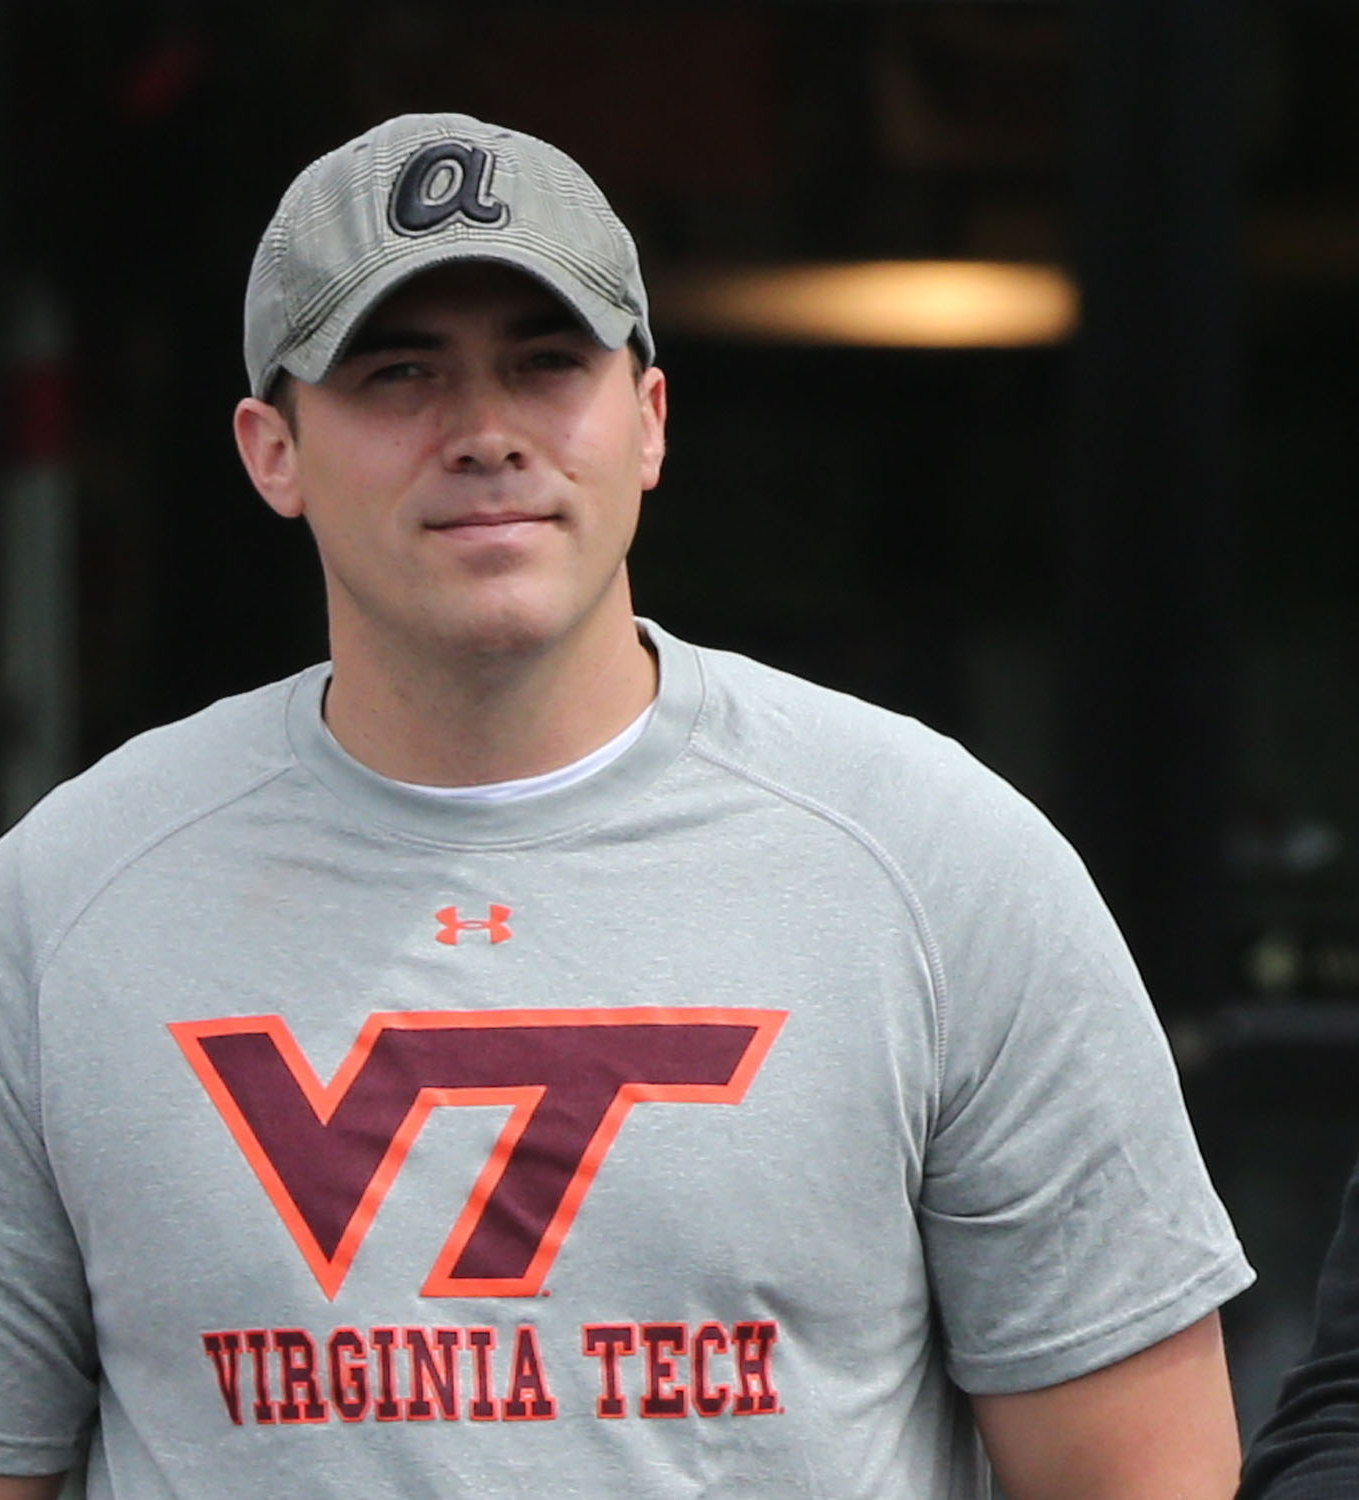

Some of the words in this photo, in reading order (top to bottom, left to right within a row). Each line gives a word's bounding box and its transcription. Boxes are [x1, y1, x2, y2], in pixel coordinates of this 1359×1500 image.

[388, 139, 509, 237] a
[166, 1007, 790, 1302] VT
[201, 1325, 557, 1425] VIRGINIA
[582, 1320, 785, 1418] TECH
